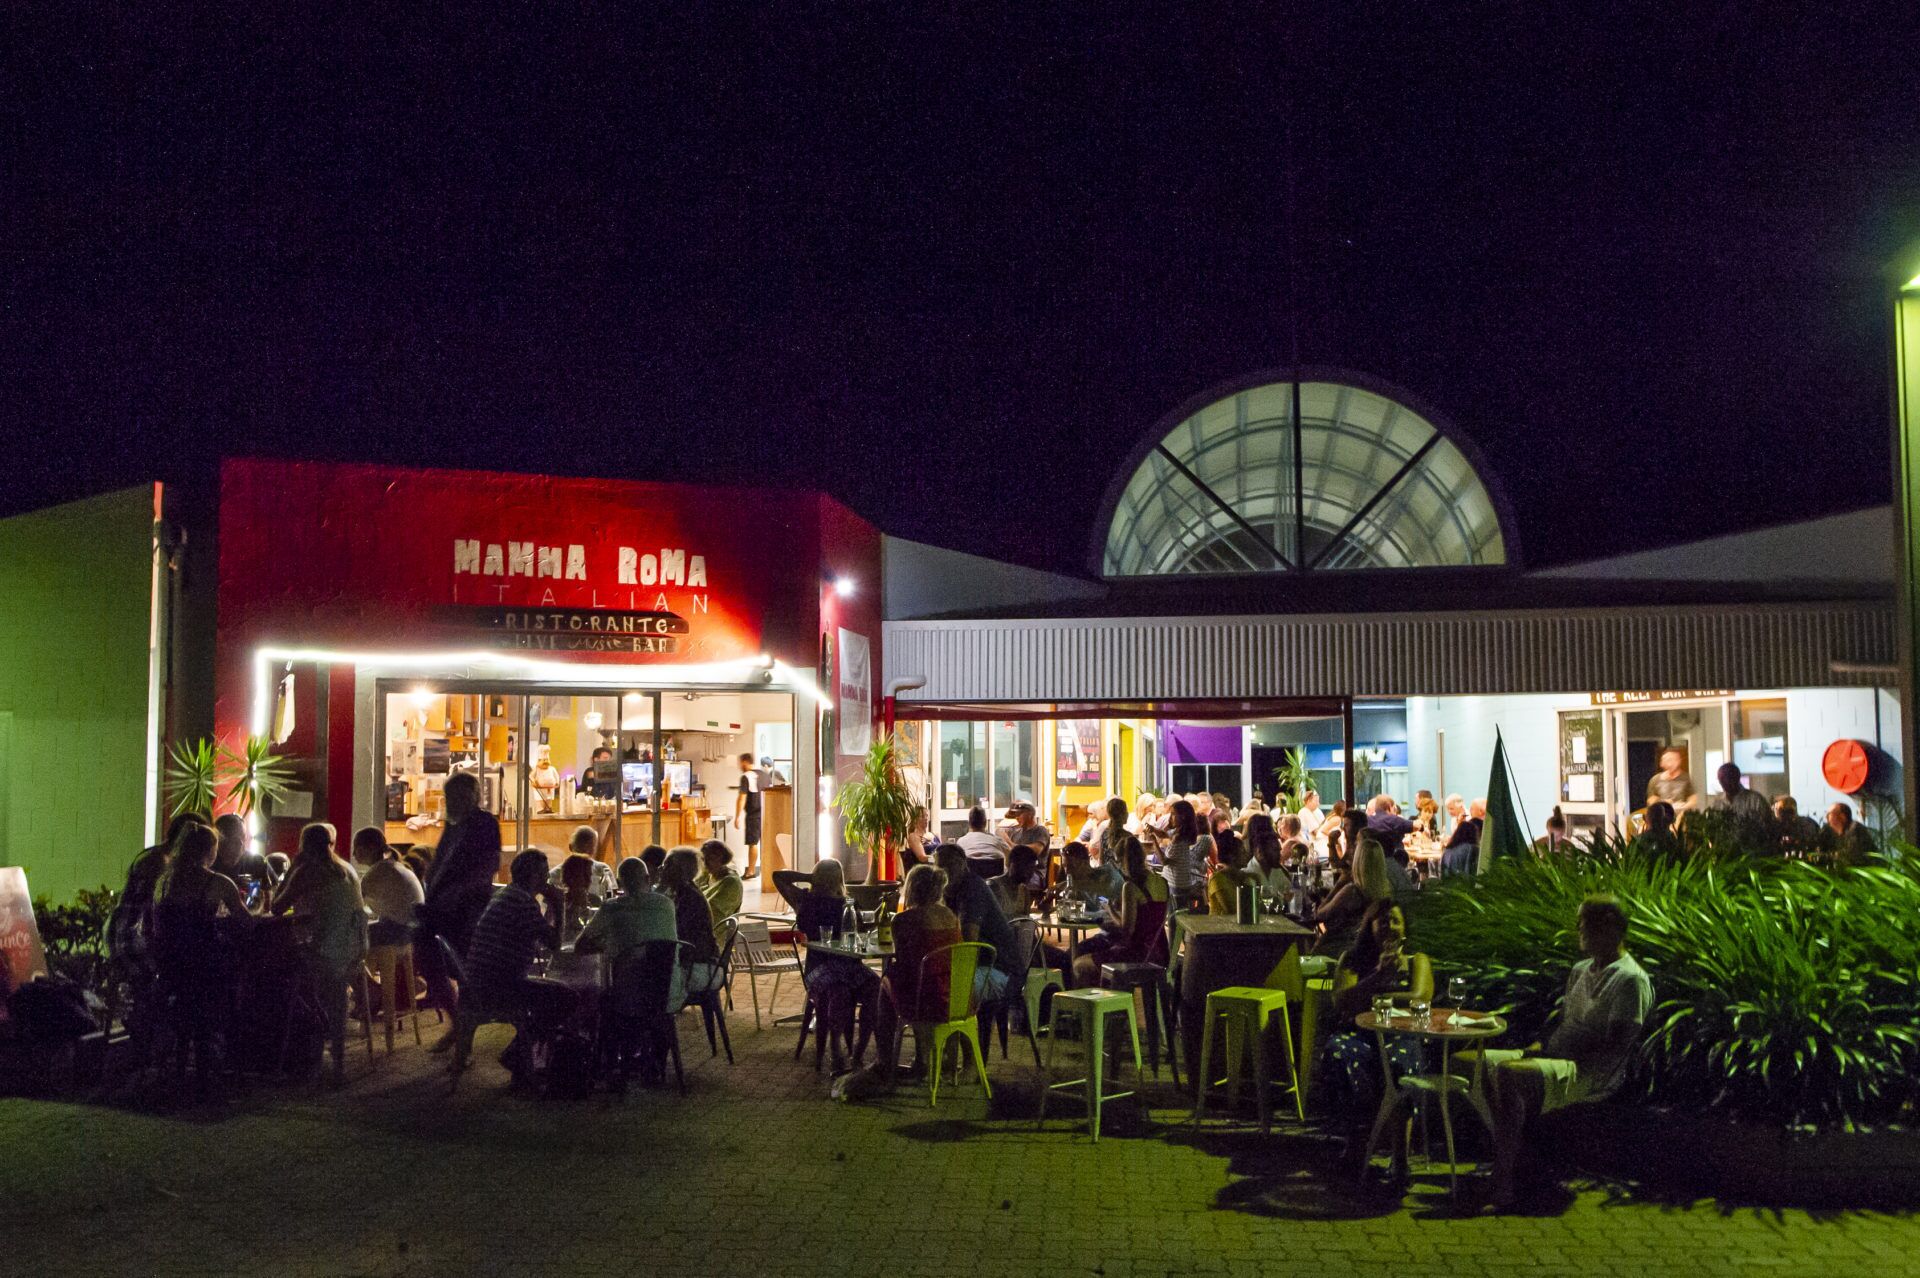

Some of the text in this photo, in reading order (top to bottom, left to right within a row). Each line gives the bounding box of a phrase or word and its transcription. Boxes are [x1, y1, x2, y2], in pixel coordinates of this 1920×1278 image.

[454, 539, 708, 588] MAMMA ROMA
[453, 584, 709, 615] ITALIAN
[505, 612, 669, 634] RISTORANTE
[633, 637, 669, 653] BAR
